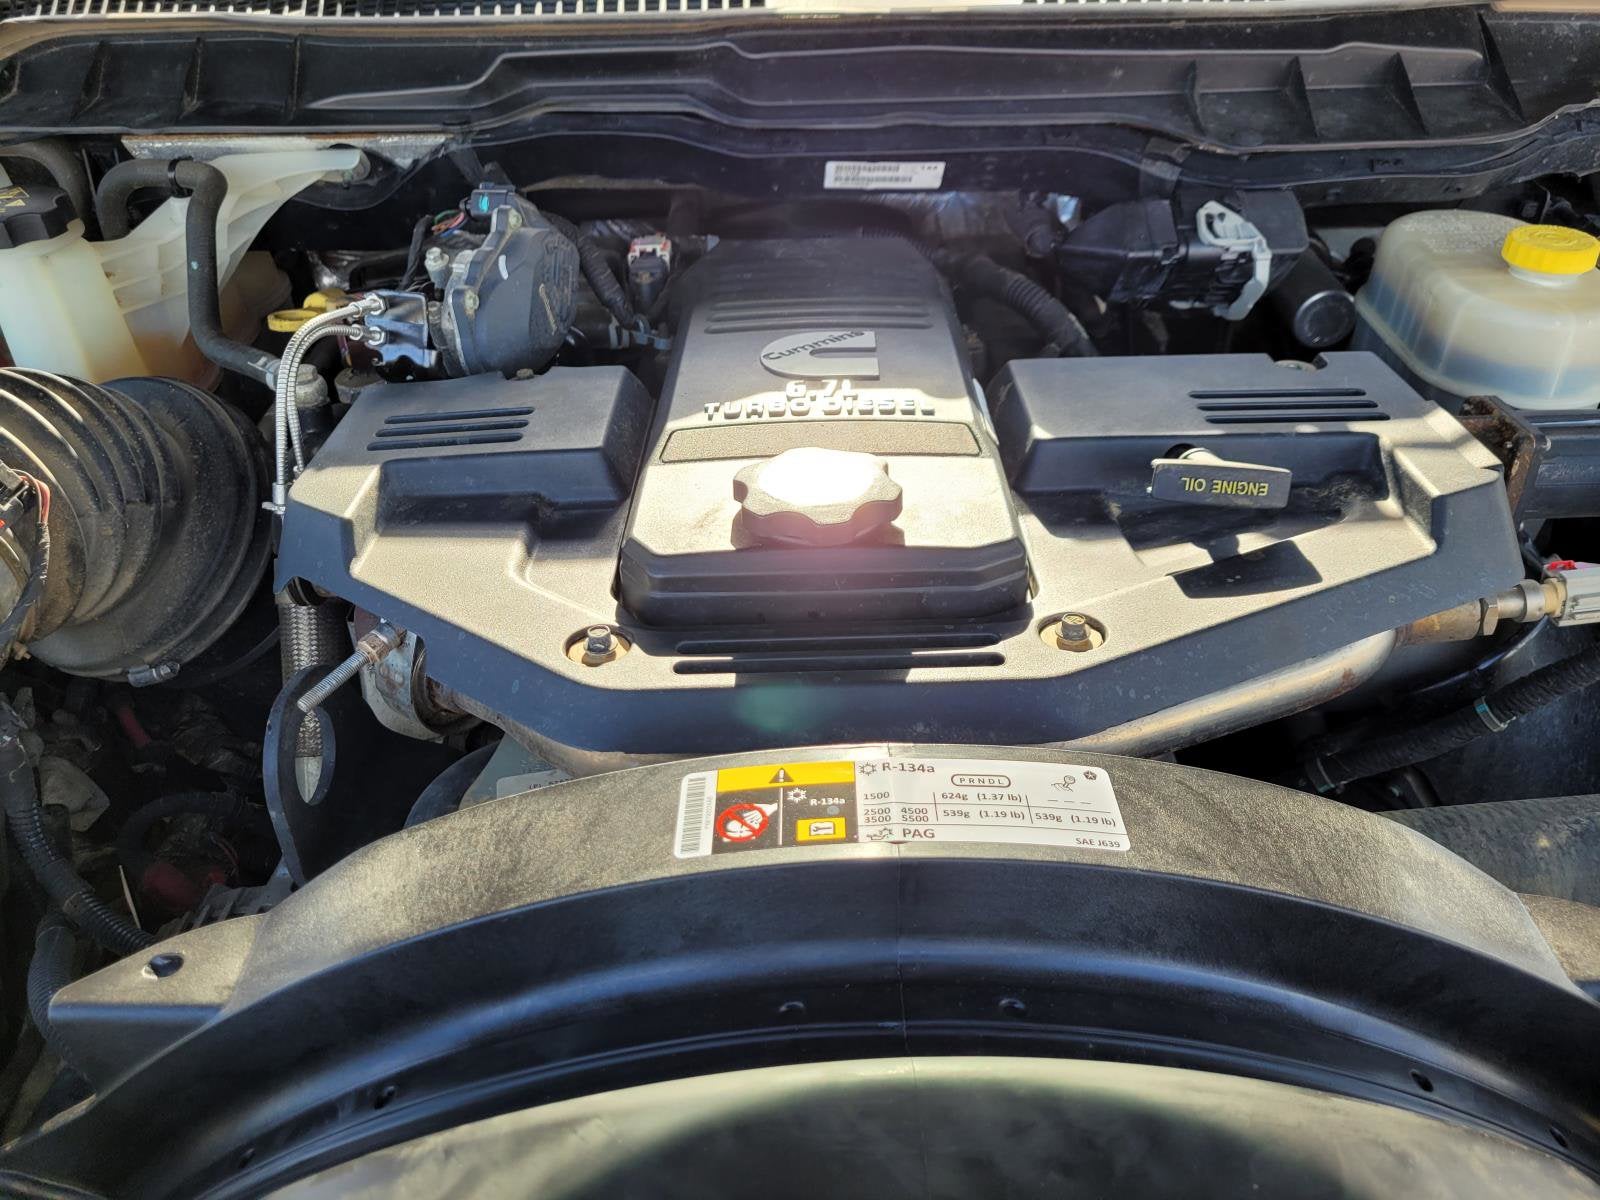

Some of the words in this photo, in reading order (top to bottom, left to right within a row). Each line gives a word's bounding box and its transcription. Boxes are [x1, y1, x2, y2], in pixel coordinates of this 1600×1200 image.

[763, 330, 865, 361] Cummins
[785, 379, 858, 401] 6.7L
[704, 399, 810, 421] TURBO
[823, 398, 935, 416] DIESEL
[1181, 477, 1206, 491] OIL
[1212, 480, 1269, 497] ENGINE
[882, 762, 935, 773] R-134a
[810, 798, 845, 806] R-134a
[864, 792, 890, 800] 1500
[942, 793, 968, 801] 624g
[977, 793, 1004, 801] (1.37
[1007, 793, 1022, 802] lb)
[864, 807, 891, 815] 2500
[901, 807, 928, 815] 4500
[943, 809, 970, 819] 539g
[979, 810, 1007, 819] (1.19
[1010, 811, 1025, 820] lb)
[864, 815, 891, 823] 3500
[1035, 812, 1062, 822] 539g
[1071, 814, 1098, 824] (1.19
[1101, 817, 1116, 827] lb)
[902, 828, 935, 839] PAG
[1075, 837, 1095, 846] SAE
[1097, 839, 1120, 848] J639
